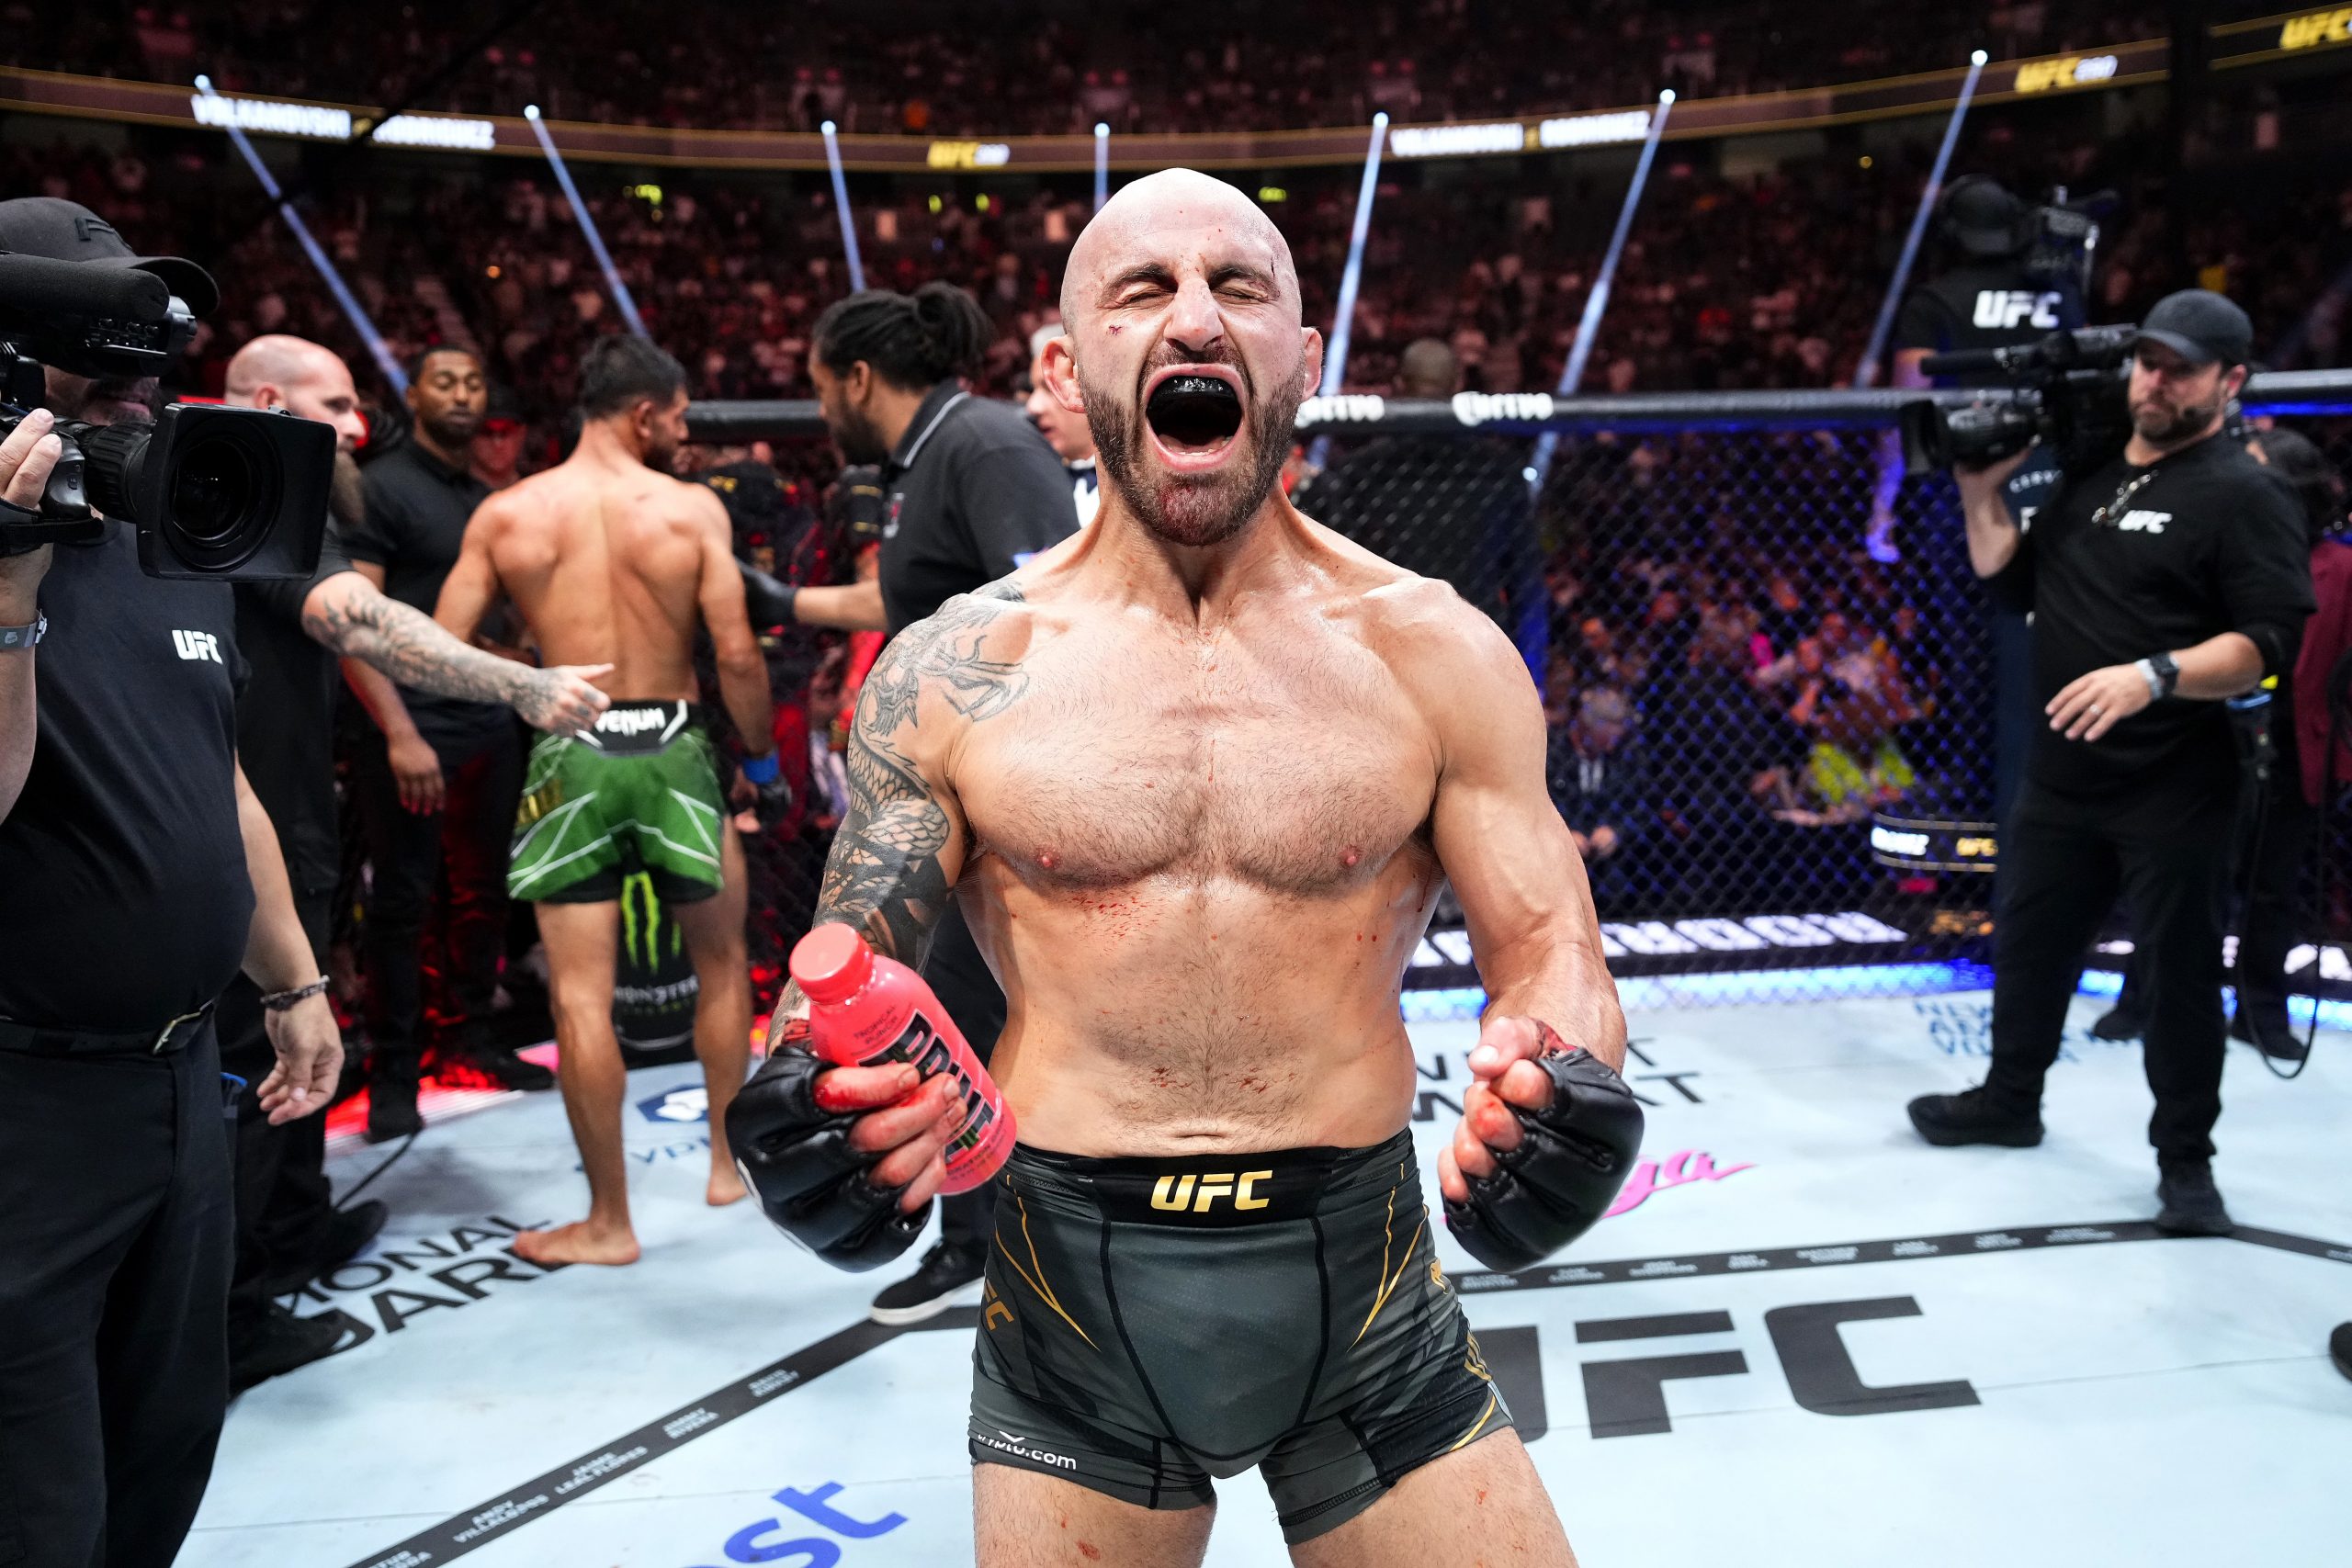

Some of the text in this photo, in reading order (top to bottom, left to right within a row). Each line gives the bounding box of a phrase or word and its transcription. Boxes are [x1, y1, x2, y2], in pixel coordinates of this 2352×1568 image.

[1973, 289, 2063, 329] UFC
[1150, 1169, 1273, 1213] UFC
[984, 1278, 1015, 1331] FC
